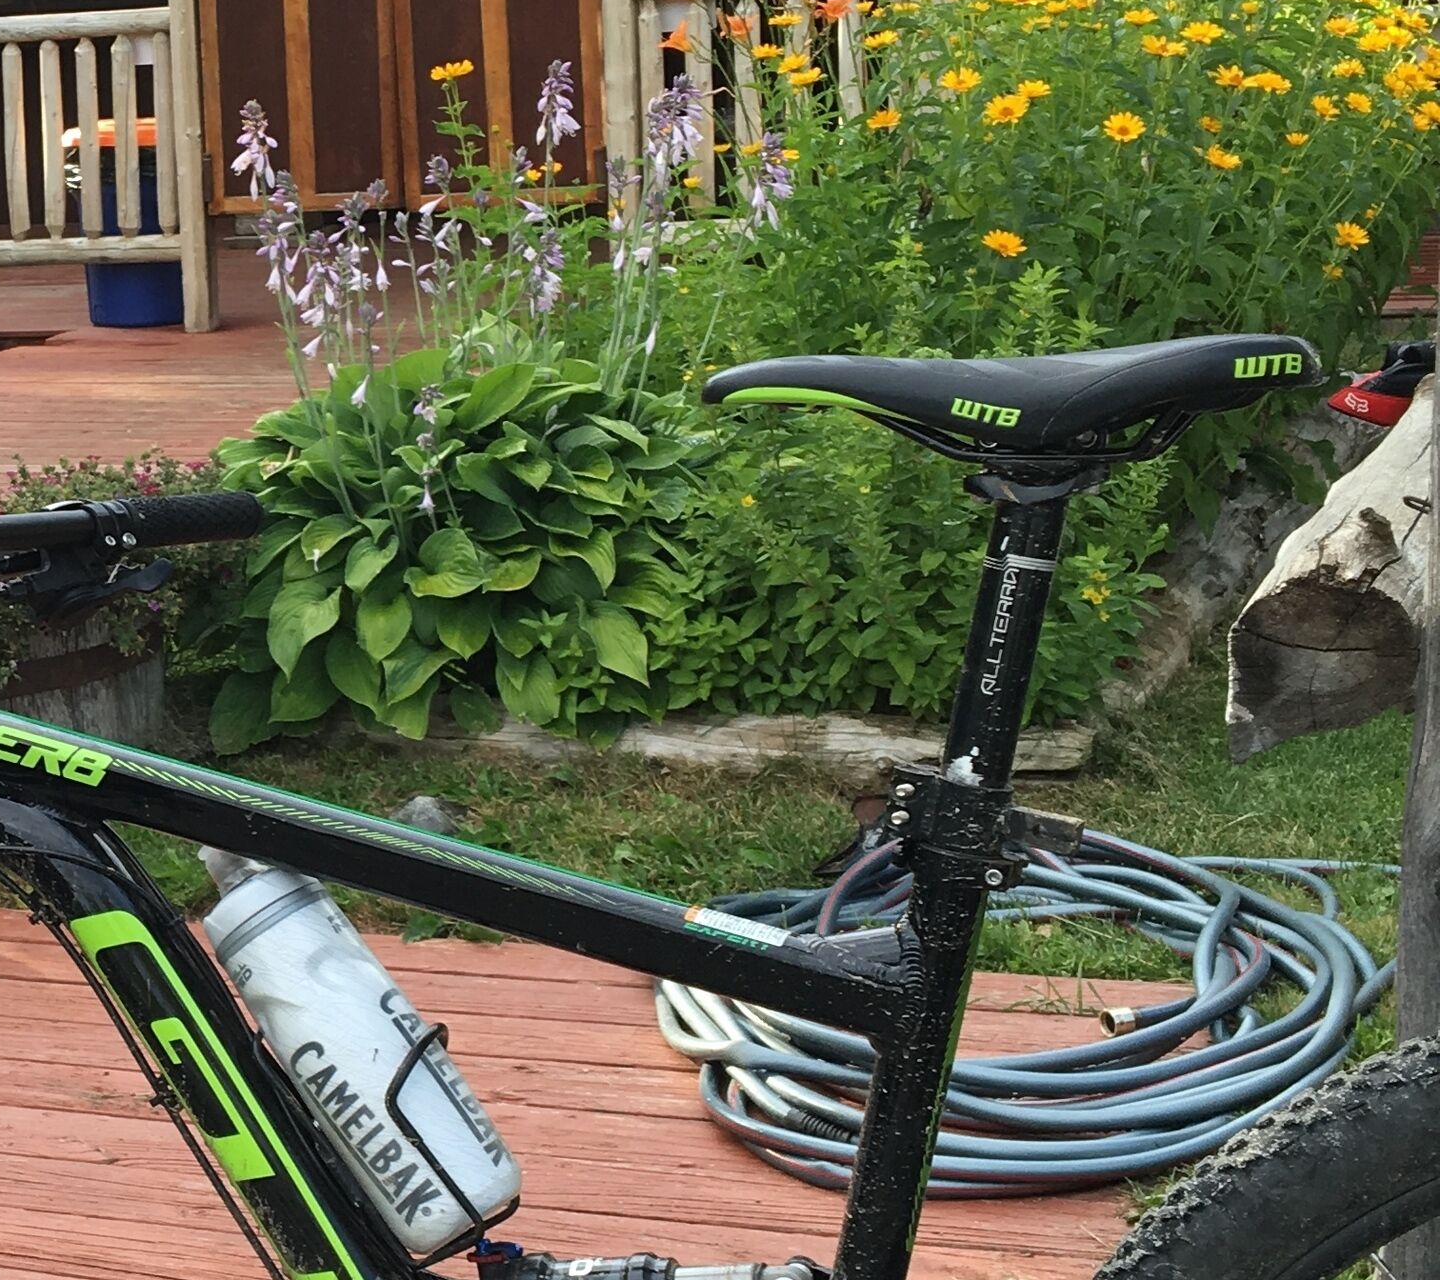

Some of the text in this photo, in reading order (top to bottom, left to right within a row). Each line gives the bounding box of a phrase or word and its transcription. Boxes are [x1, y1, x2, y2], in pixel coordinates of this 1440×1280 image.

[1234, 353, 1303, 379] WTB
[951, 397, 1022, 428] WTB
[290, 1040, 438, 1227] CAMELBAK
